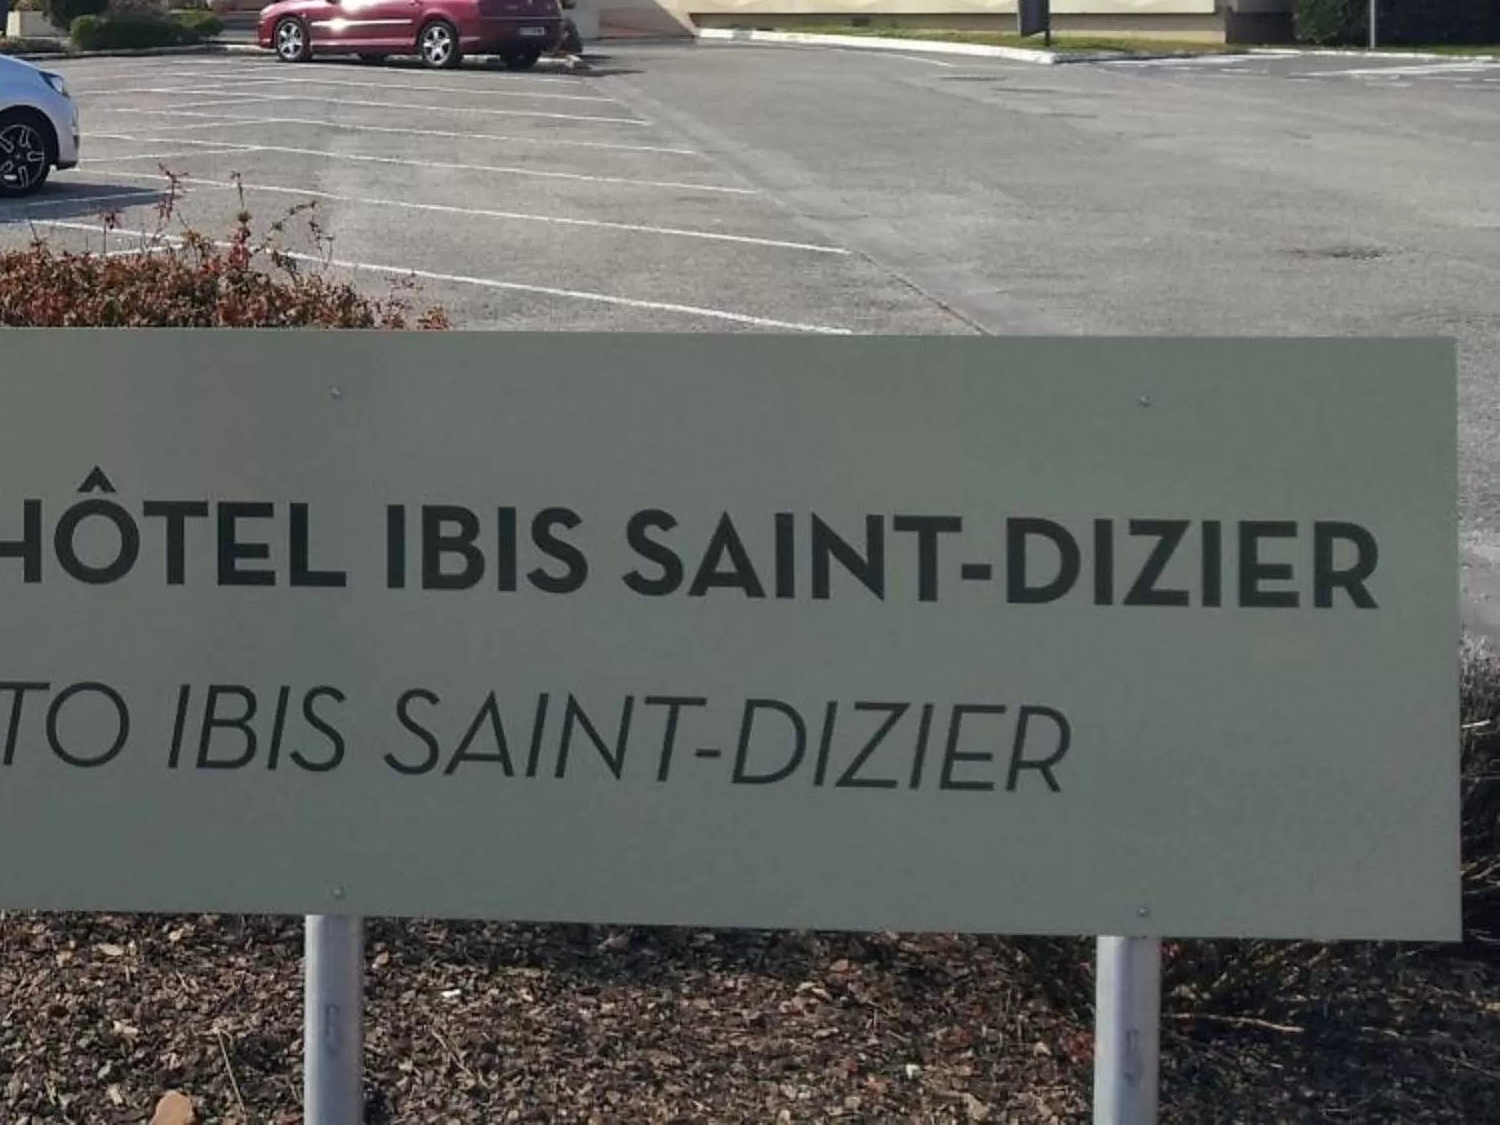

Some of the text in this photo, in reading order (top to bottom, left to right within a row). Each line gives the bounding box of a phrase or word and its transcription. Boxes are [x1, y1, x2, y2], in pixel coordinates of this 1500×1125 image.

[386, 503, 589, 595] IBIS
[621, 508, 1380, 610] SAINT-DIZIER
[167, 682, 347, 773] IBIS
[383, 688, 1071, 793] SAINT-DIZIER
